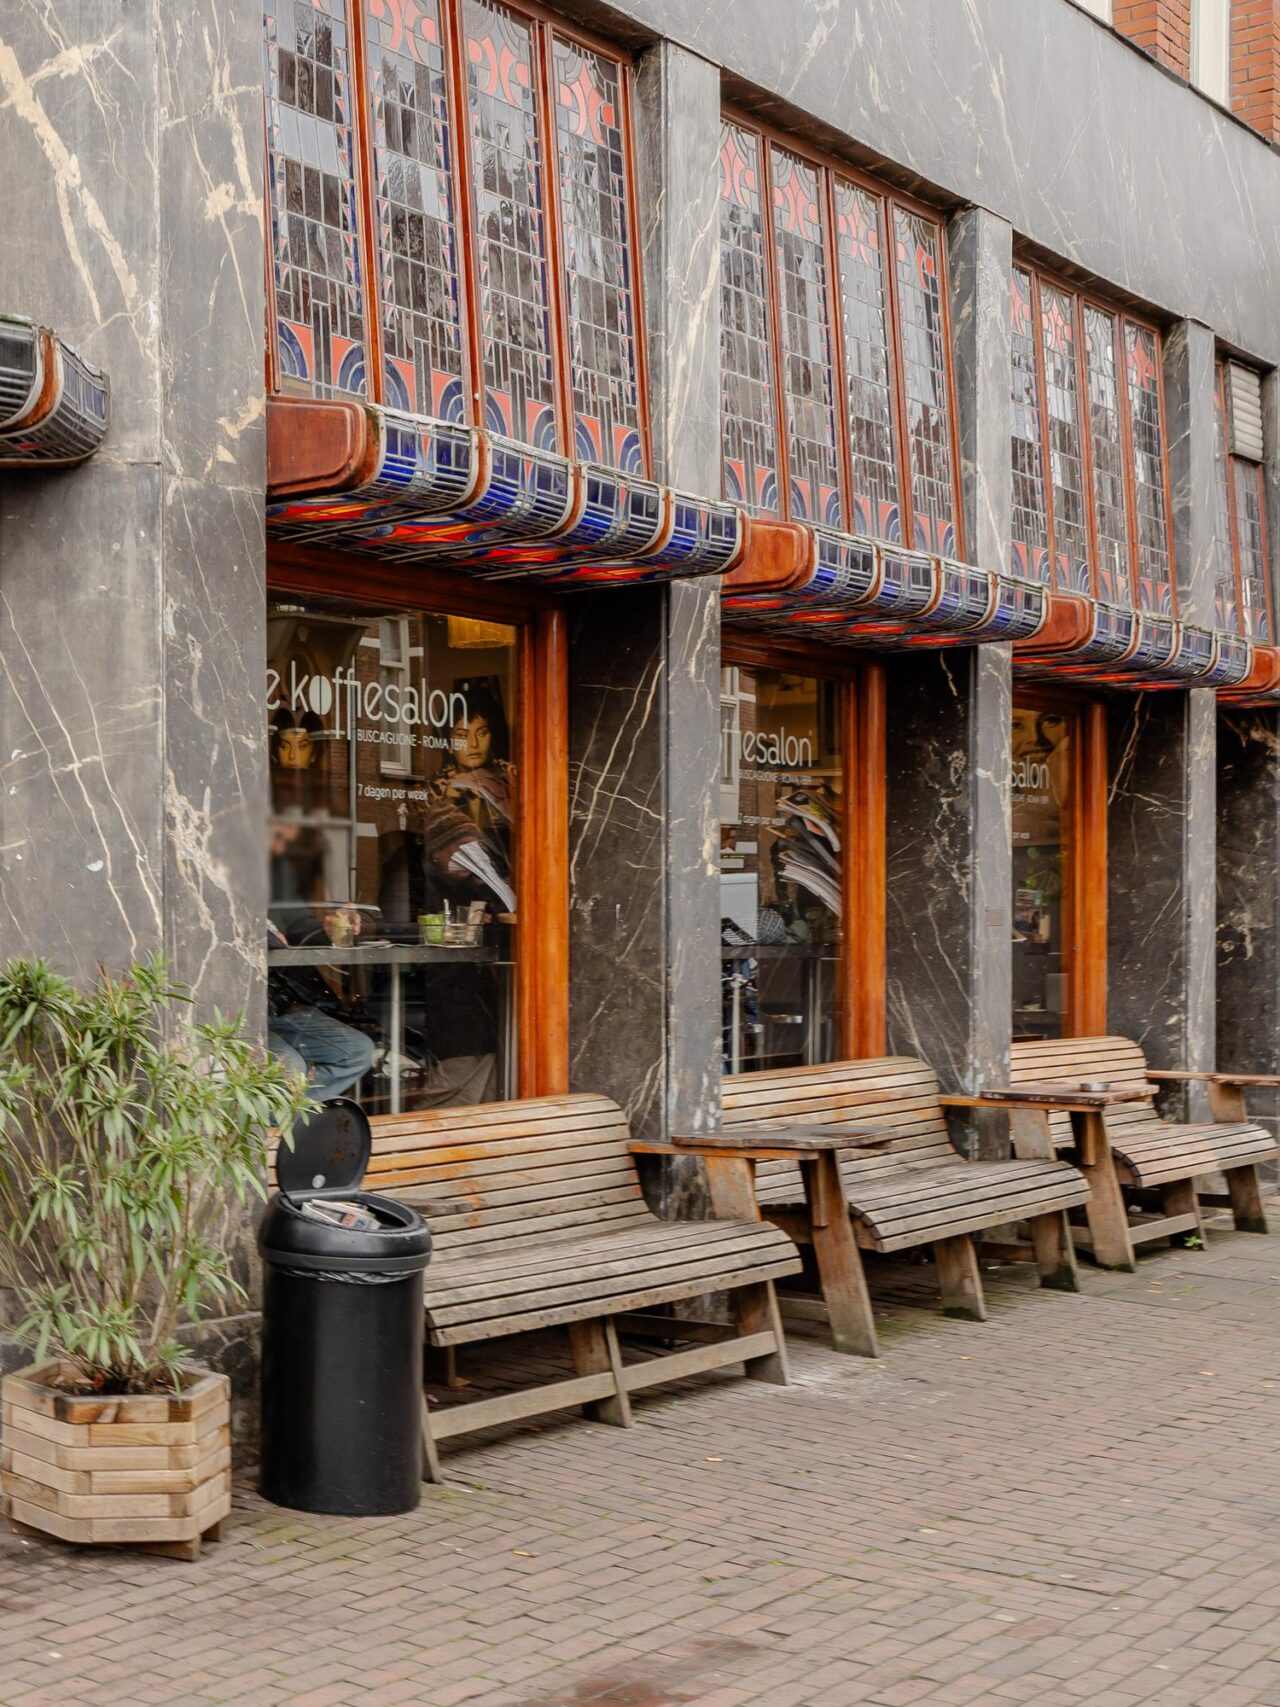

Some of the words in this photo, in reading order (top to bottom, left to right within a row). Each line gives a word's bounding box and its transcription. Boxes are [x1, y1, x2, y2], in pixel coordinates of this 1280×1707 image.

[291, 660, 469, 740] koffiesalon
[357, 729, 417, 747] BUSCAGLIONE
[423, 736, 449, 749] ROMA
[450, 738, 468, 751] 1899
[357, 784, 363, 796] 7
[364, 785, 391, 801] dagen
[392, 789, 406, 800] per
[407, 790, 429, 801] week
